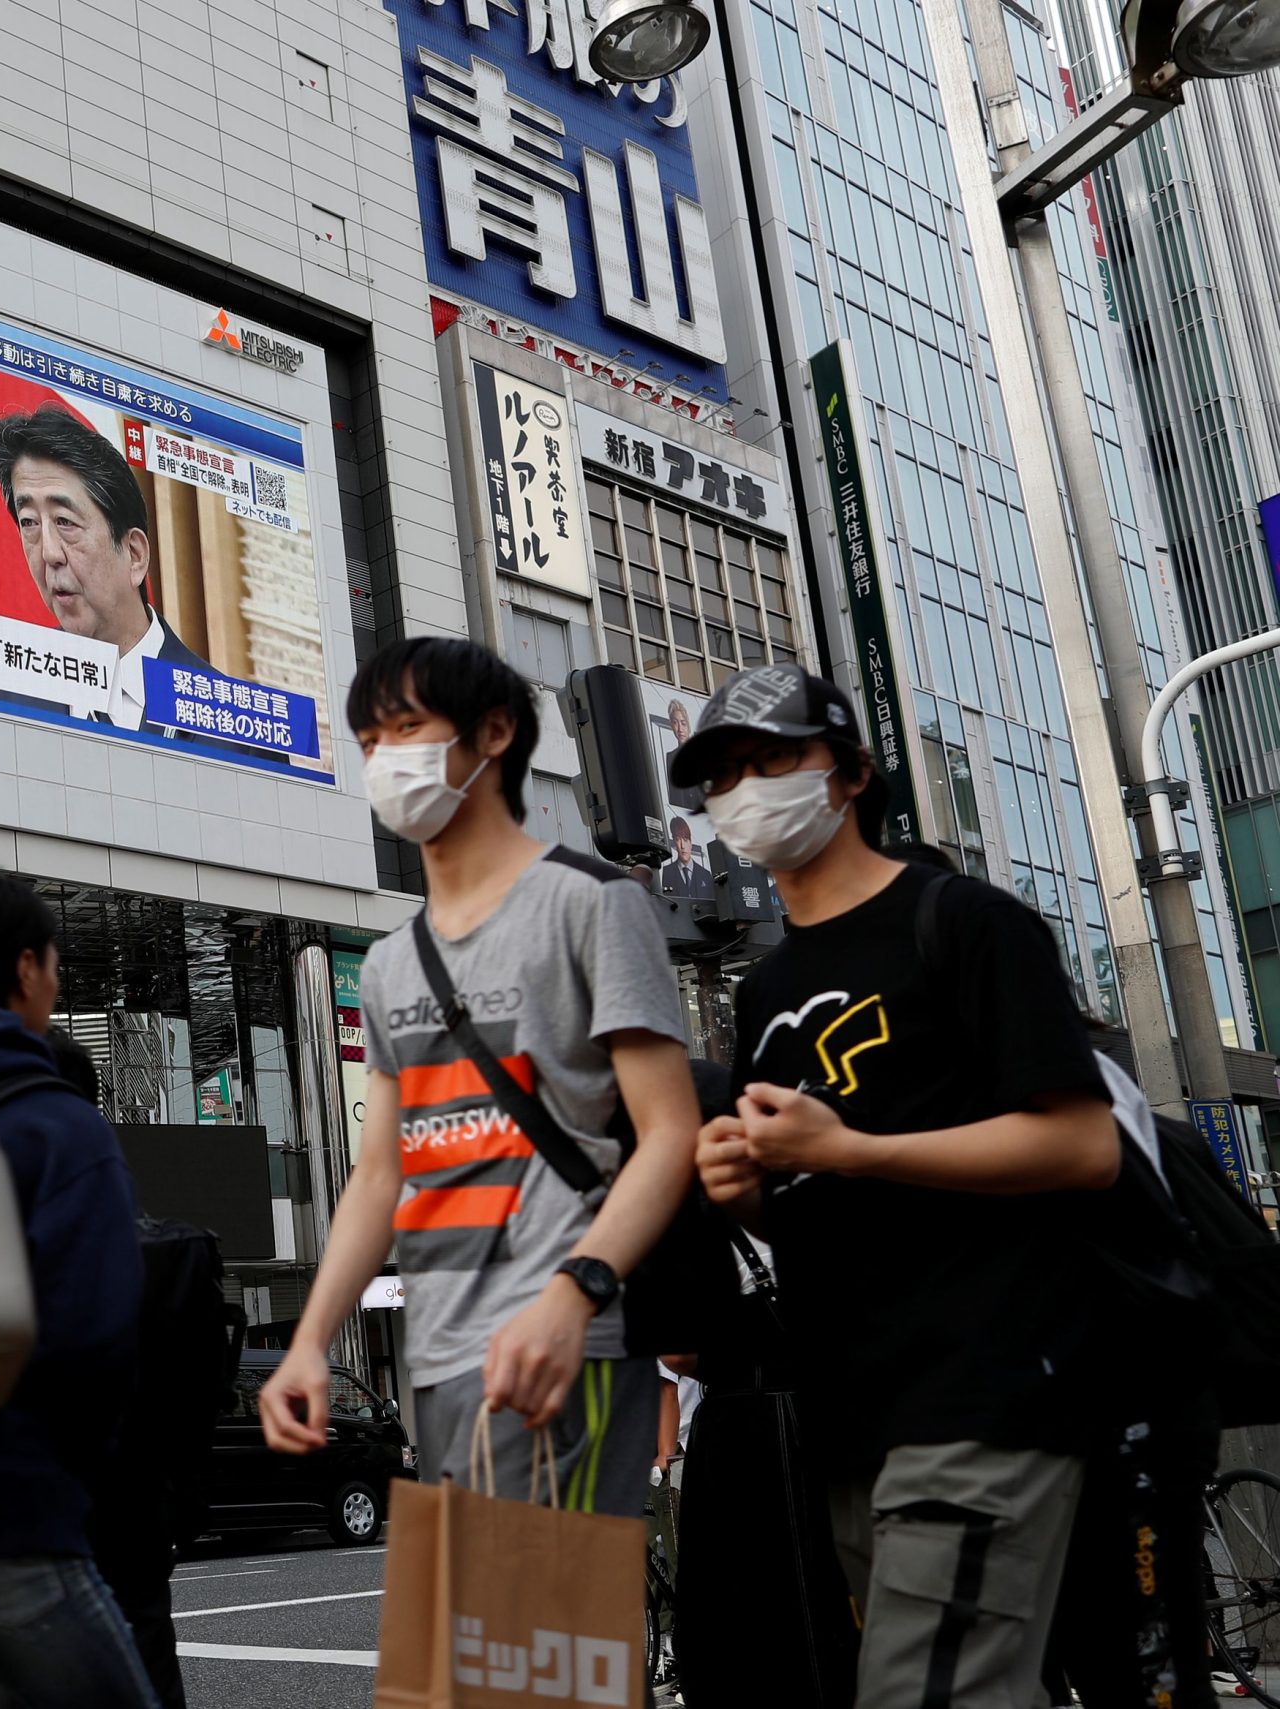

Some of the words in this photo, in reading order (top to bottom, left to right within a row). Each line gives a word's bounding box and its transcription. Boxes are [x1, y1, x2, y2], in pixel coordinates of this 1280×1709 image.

[412, 44, 727, 365] 青山
[240, 327, 305, 365] MITSUBISHI
[241, 343, 299, 374] ELECTRIC
[127, 426, 142, 462] 中継
[155, 434, 236, 476] 緊急事態宣言
[831, 417, 849, 475] SMBC
[488, 458, 510, 535] 地下1階
[504, 390, 550, 569] ルノアール
[543, 434, 569, 539] 喫茶室
[232, 500, 292, 531] ネットでも配信
[839, 481, 871, 599] 三井住友銀行
[171, 667, 290, 720] 緊急事態宣言
[174, 697, 293, 748] 解除後の対応
[1211, 1106, 1243, 1194] 防犯カメラ作
[454, 1615, 629, 1706] ビックロ
